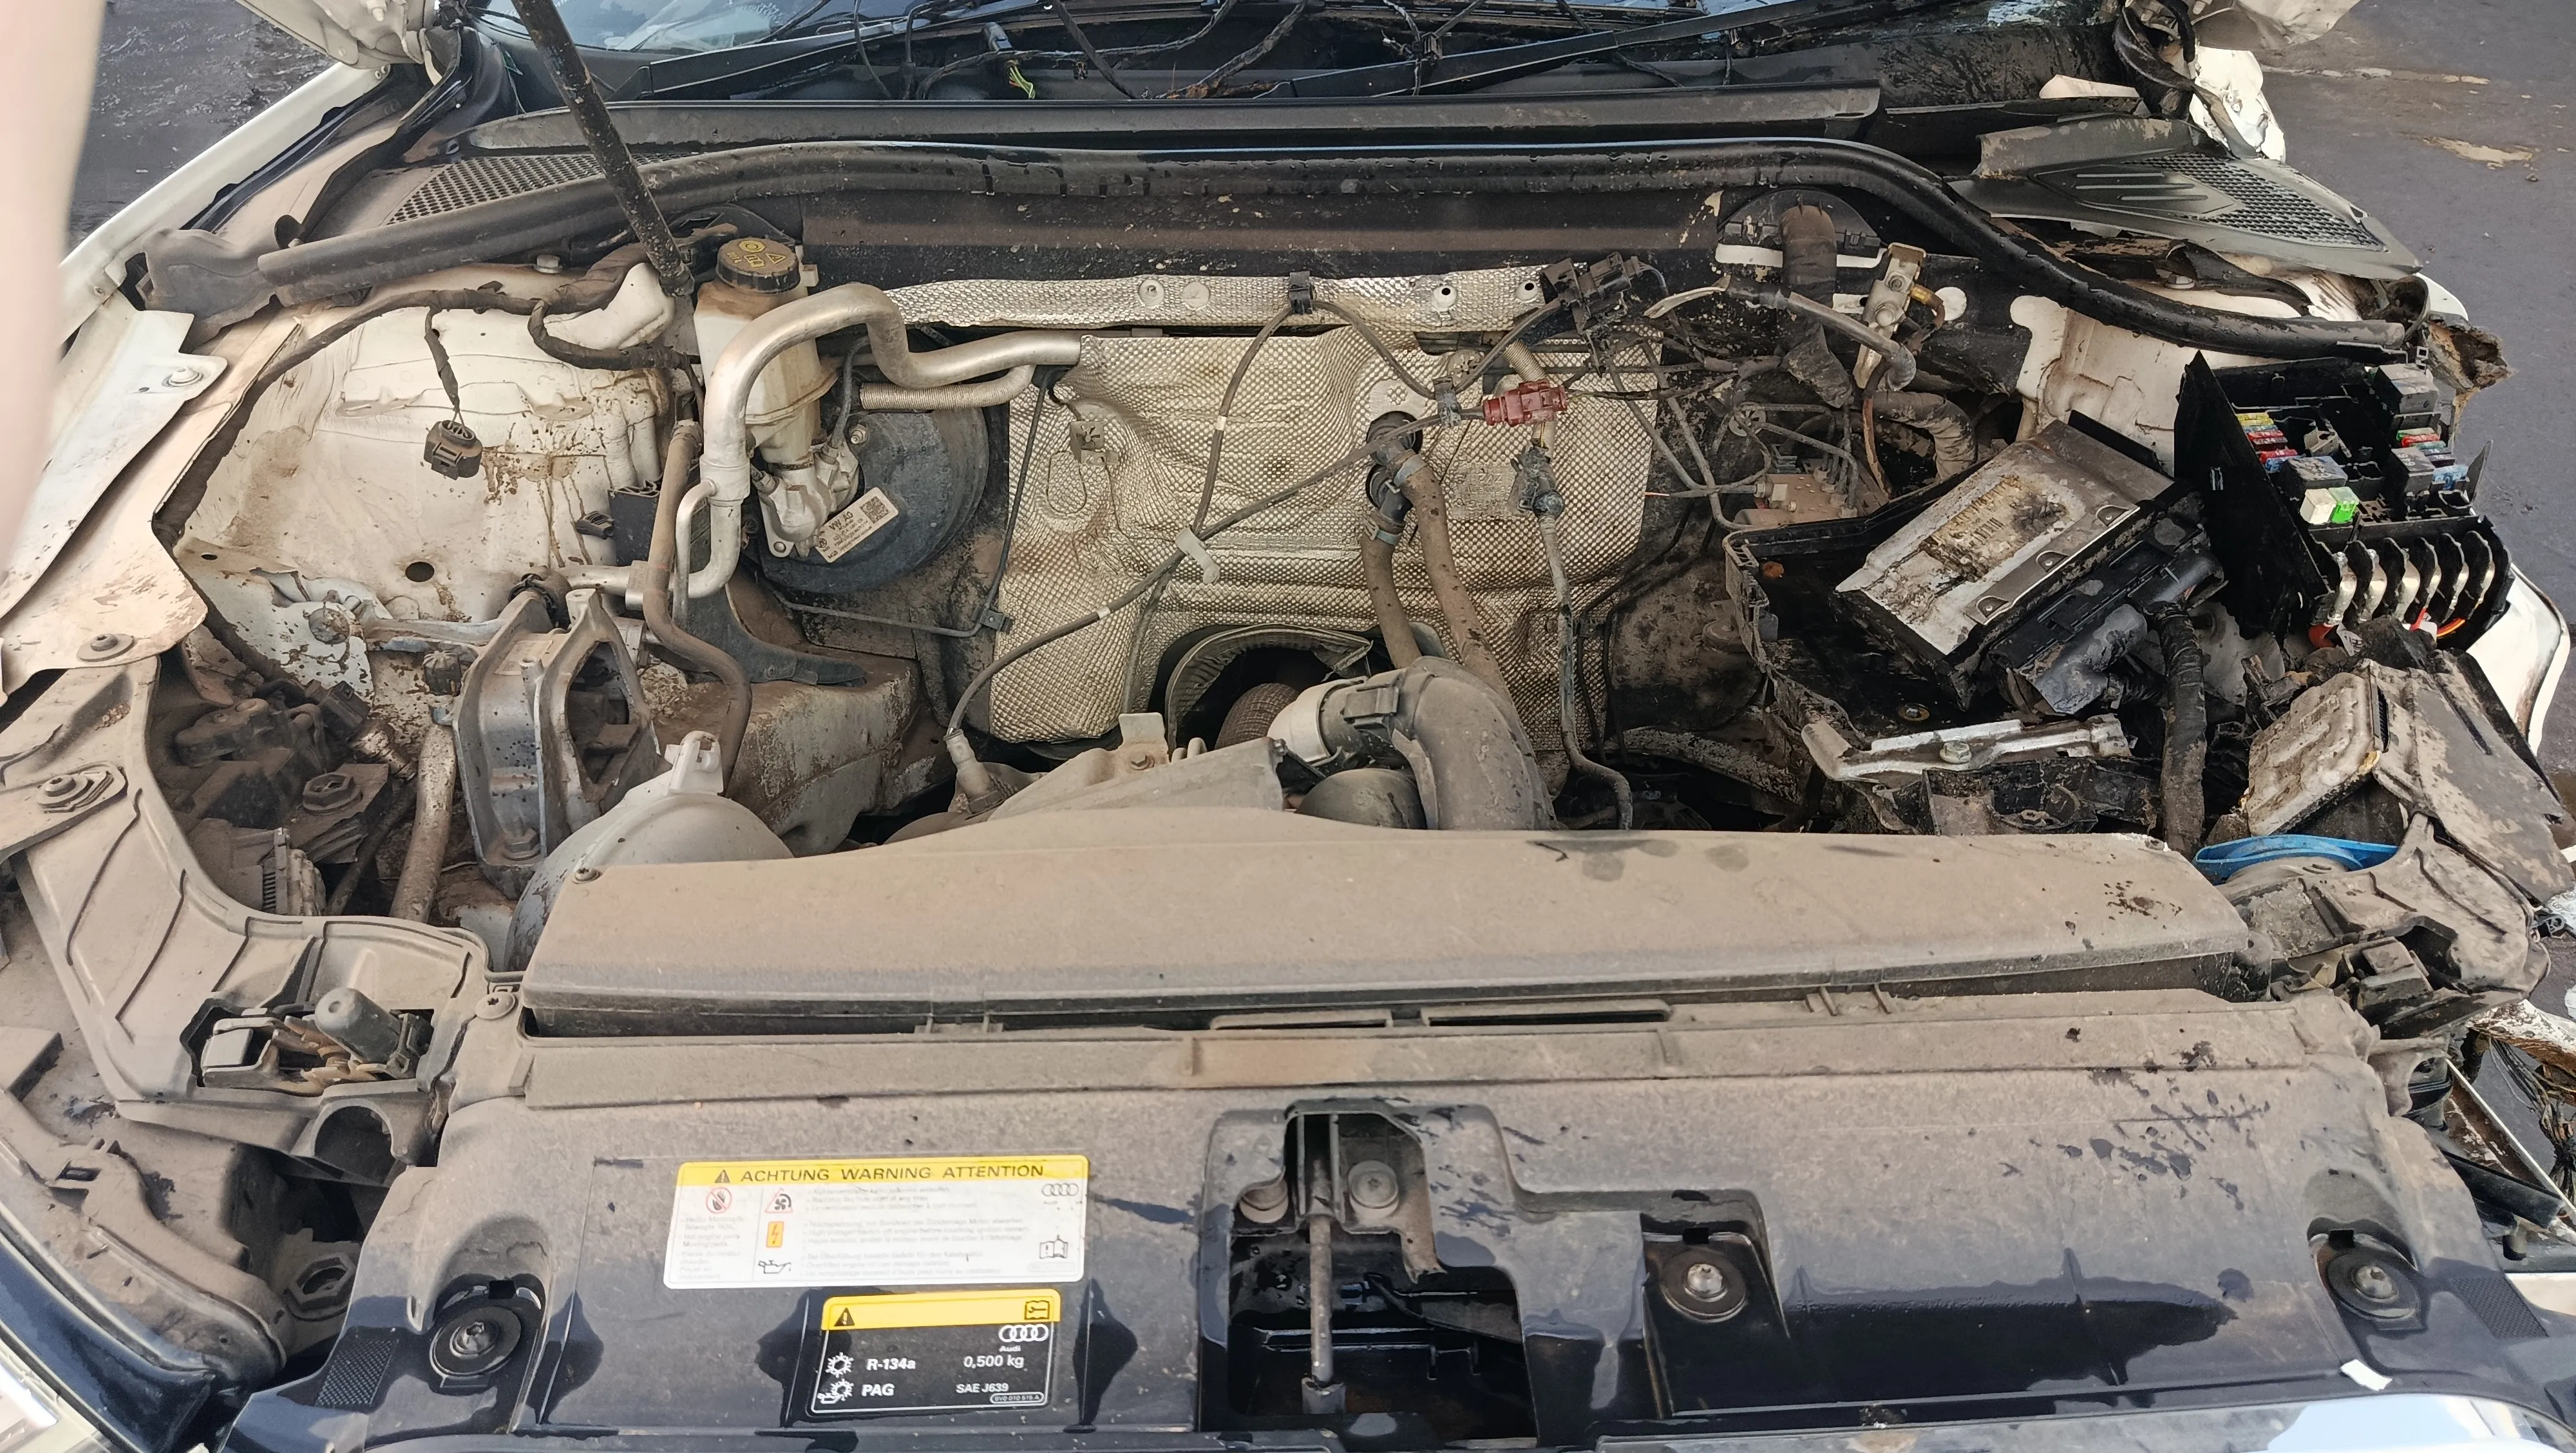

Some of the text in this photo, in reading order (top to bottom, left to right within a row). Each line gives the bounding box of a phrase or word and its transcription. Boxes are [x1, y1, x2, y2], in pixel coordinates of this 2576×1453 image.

[842, 511, 853, 520] AG
[740, 1164, 1044, 1182] ACHTUNG WARNING ATTENTION
[866, 1354, 1025, 1370] R-134a 0,500 kg
[862, 1383, 1009, 1396] PAG SAE J639
